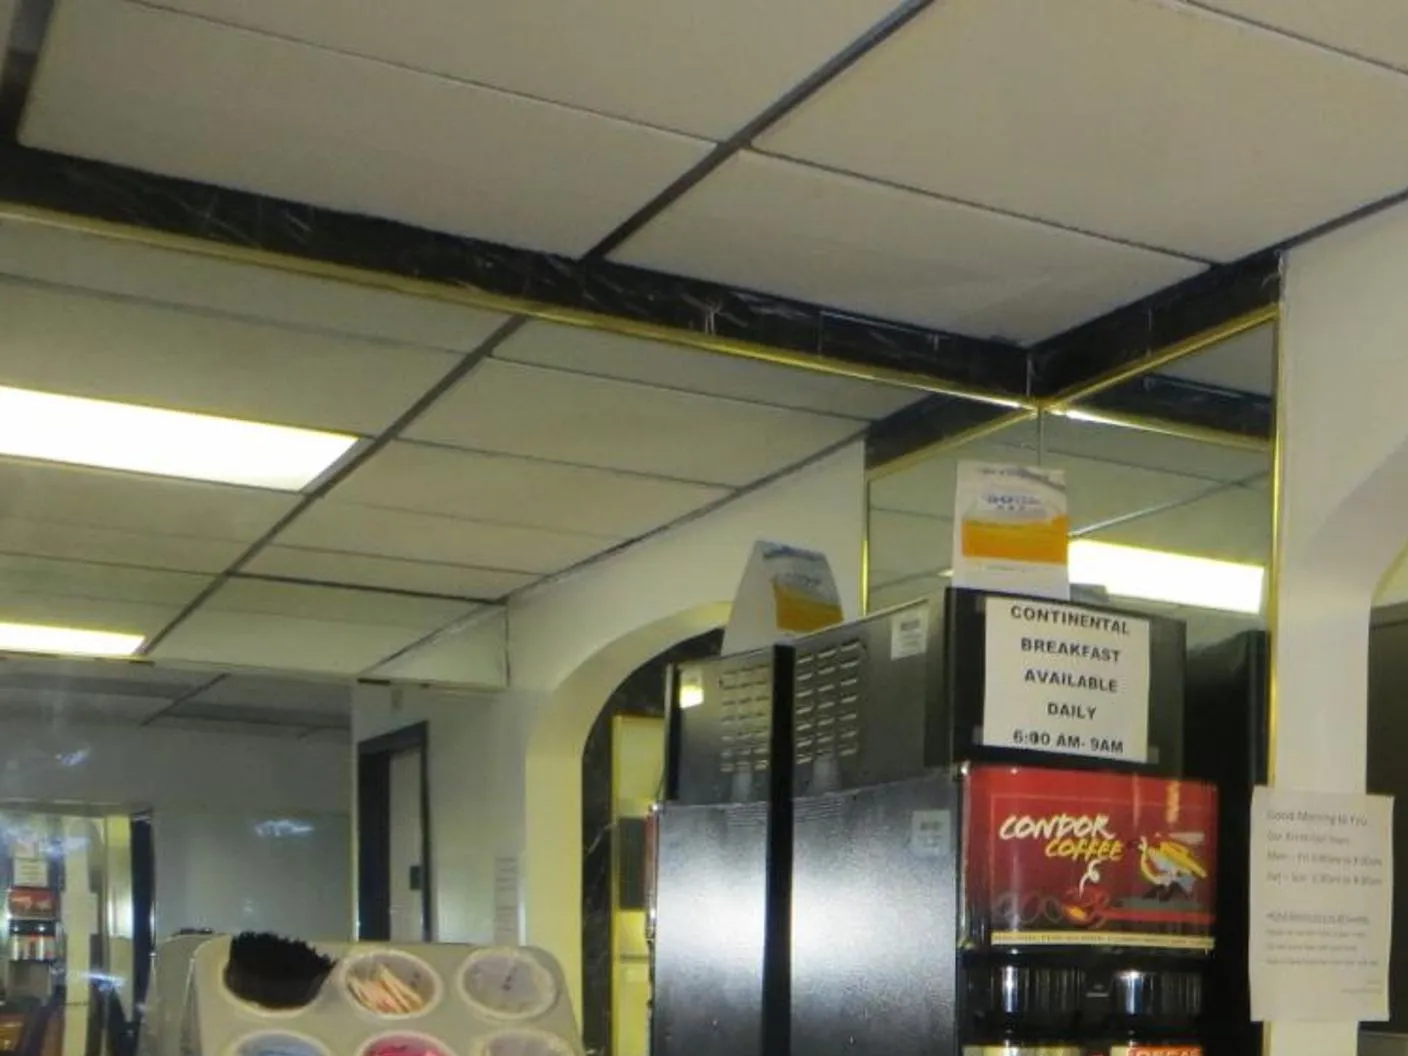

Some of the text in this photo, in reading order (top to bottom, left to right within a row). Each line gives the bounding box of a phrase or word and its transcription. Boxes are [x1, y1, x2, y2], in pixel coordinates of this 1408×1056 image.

[1010, 604, 1130, 635] CONTINENTAL
[1020, 637, 1121, 663] BREAKFAST
[1024, 668, 1119, 692] AVAILABLE
[1047, 702, 1097, 720] DAILY
[1013, 729, 1050, 745] 6:00
[1090, 738, 1124, 753] 9AM
[1000, 813, 1117, 840] CONDOR
[1045, 838, 1125, 861] COFFEE
